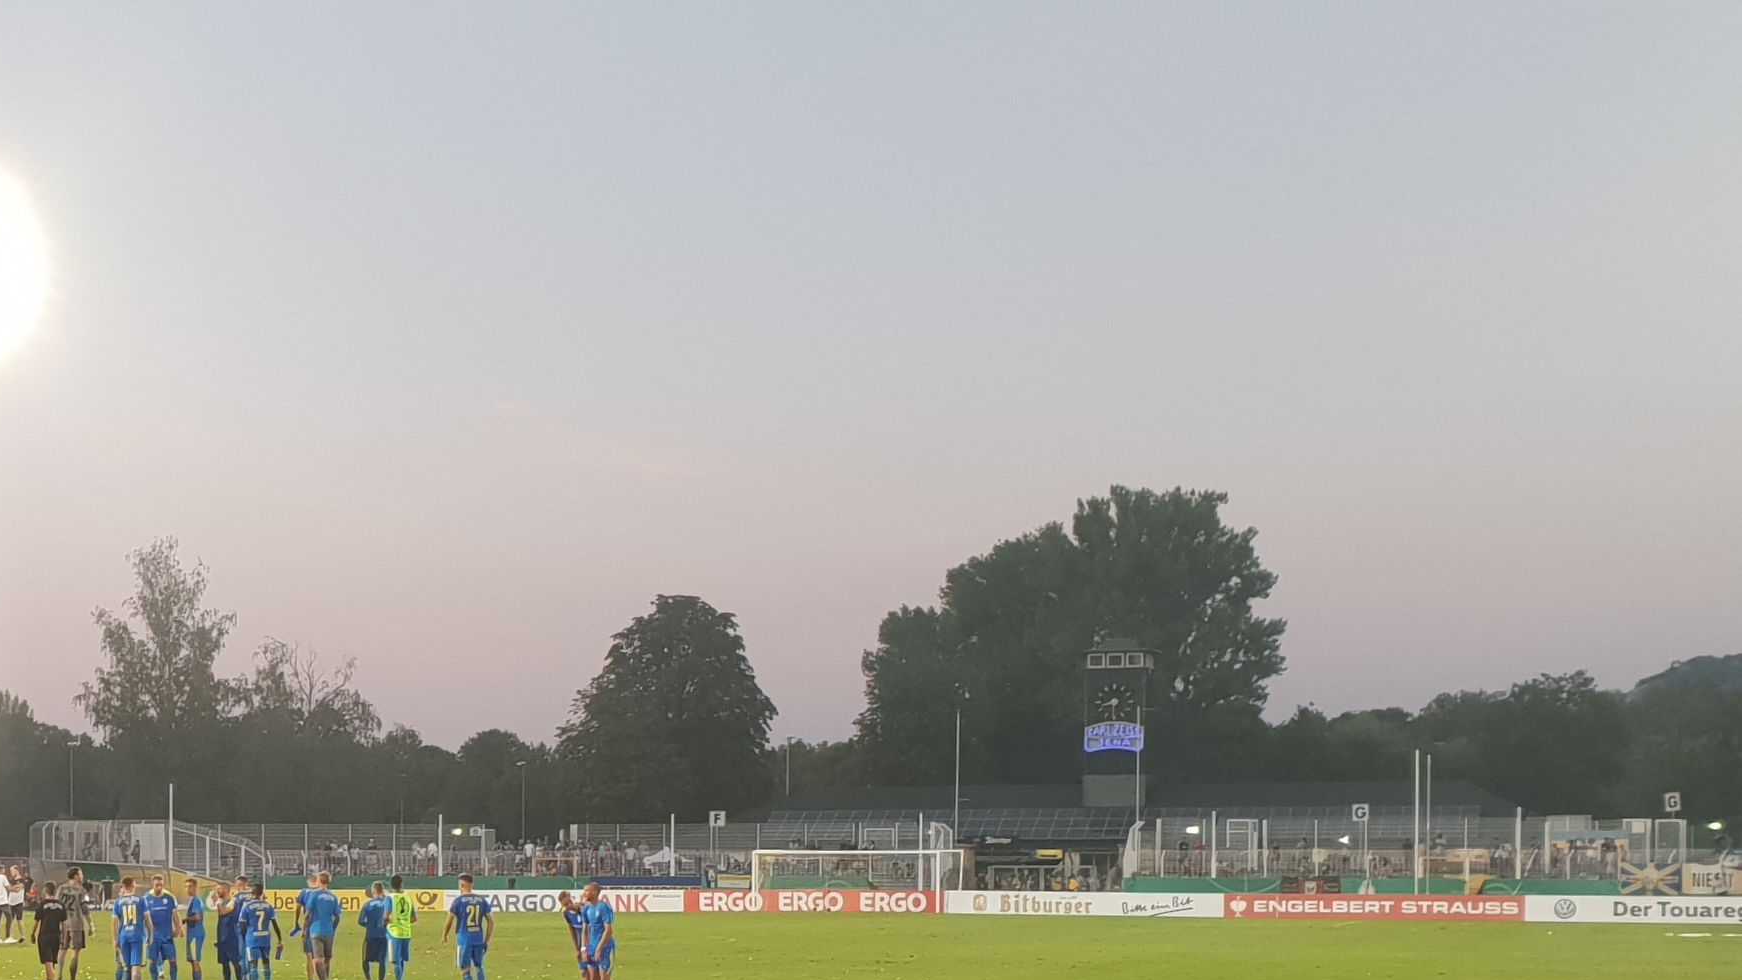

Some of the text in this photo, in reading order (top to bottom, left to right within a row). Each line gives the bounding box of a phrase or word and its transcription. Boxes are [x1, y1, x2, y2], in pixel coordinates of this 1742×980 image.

[1667, 795, 1678, 808] G
[714, 813, 721, 824] F
[1354, 806, 1367, 819] G
[699, 891, 928, 912] ERGO ERGO ERGO
[1000, 894, 1092, 914] Bitburger
[1253, 900, 1519, 914] ENGELBERT STRAUSS
[122, 904, 137, 926] 14
[255, 911, 265, 930] 7
[466, 905, 480, 926] 21
[1613, 901, 1742, 922] Der Touare
